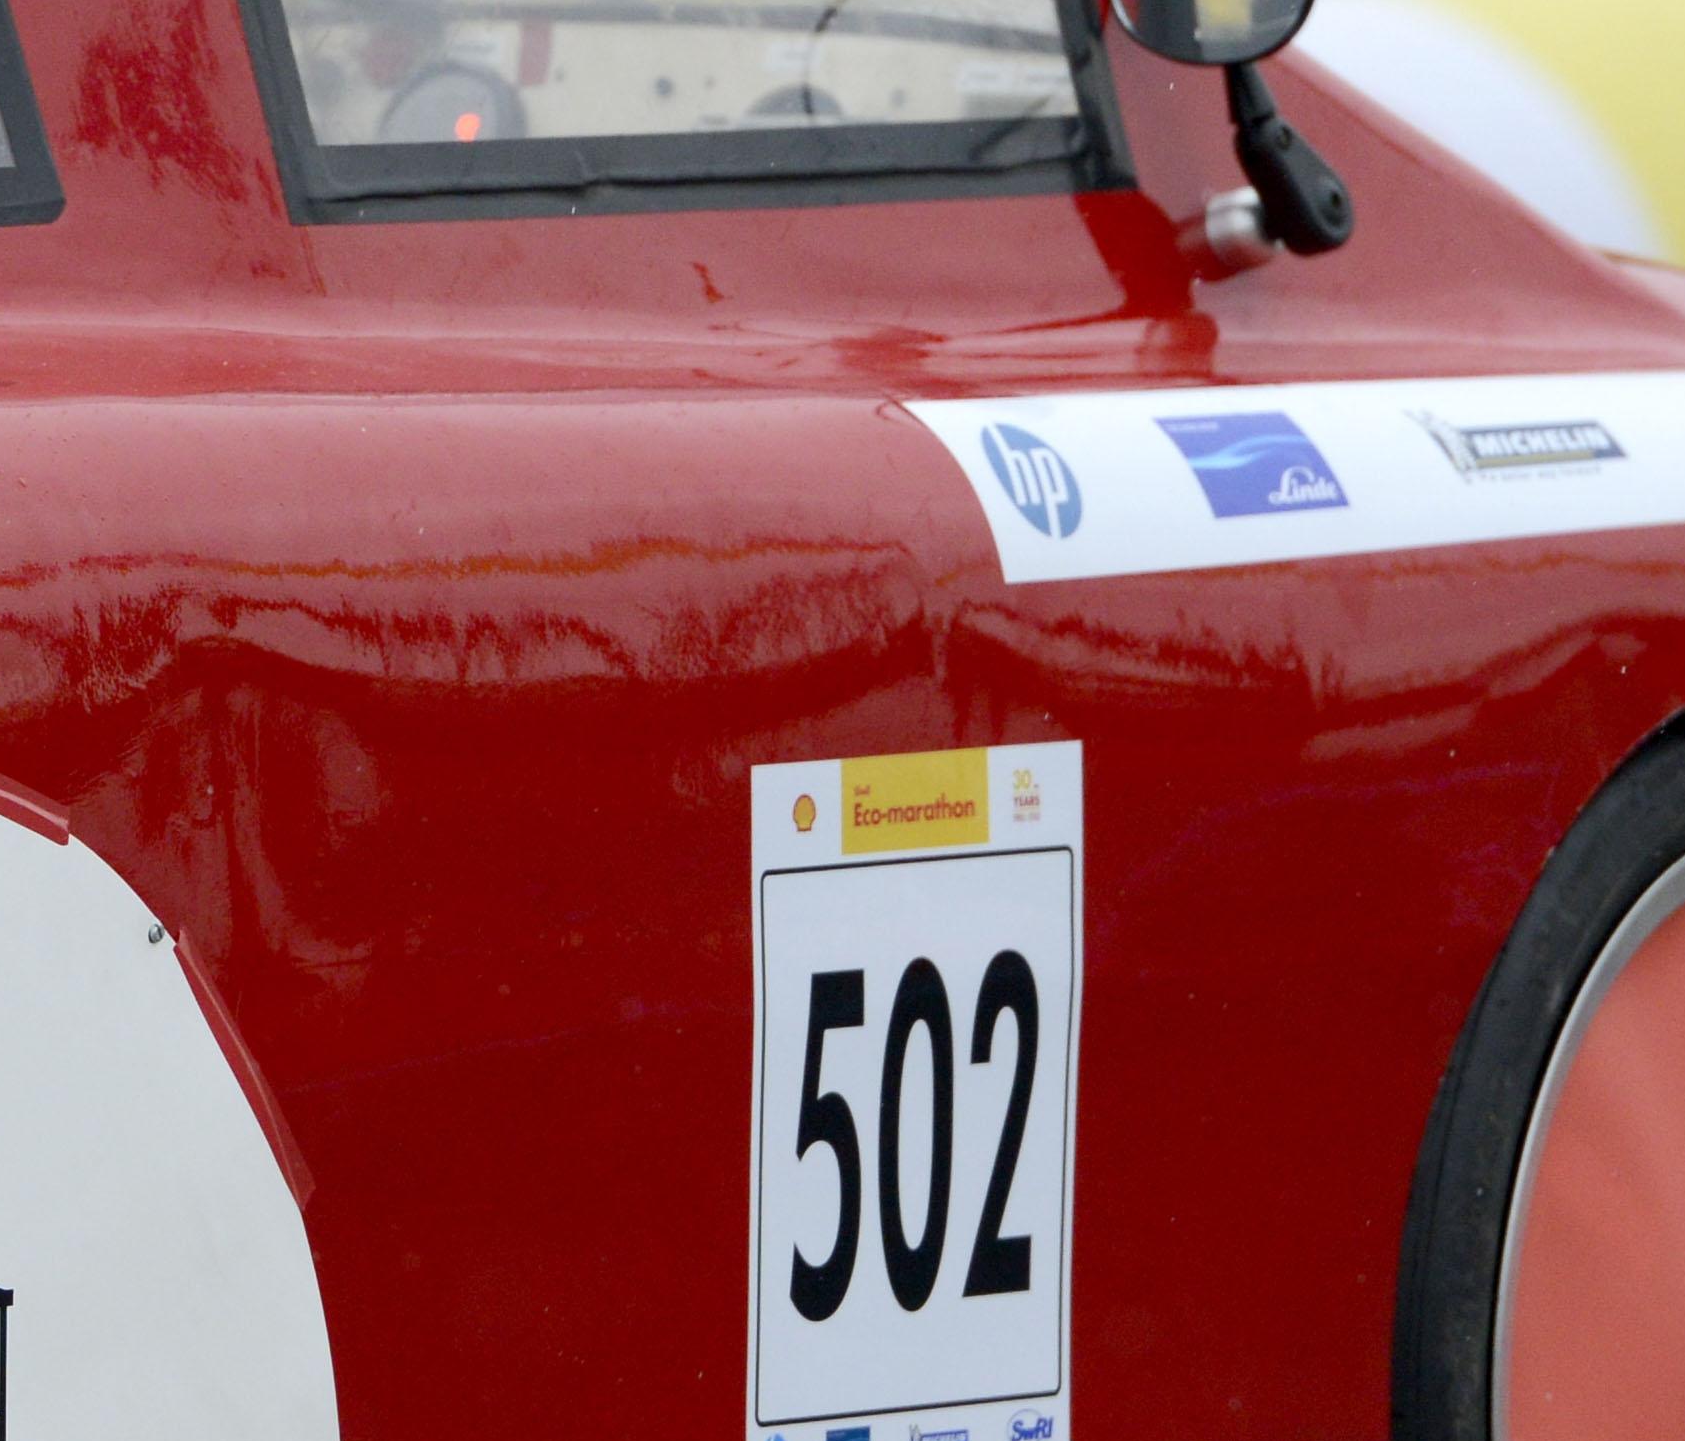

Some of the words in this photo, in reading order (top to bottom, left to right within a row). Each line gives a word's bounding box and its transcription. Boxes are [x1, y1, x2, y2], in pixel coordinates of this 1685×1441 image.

[1472, 425, 1612, 458] MICHELIN
[986, 423, 1070, 540] hp
[1268, 466, 1339, 506] Linde
[854, 792, 975, 826] Eco-marathon
[790, 949, 1039, 1322] 502
